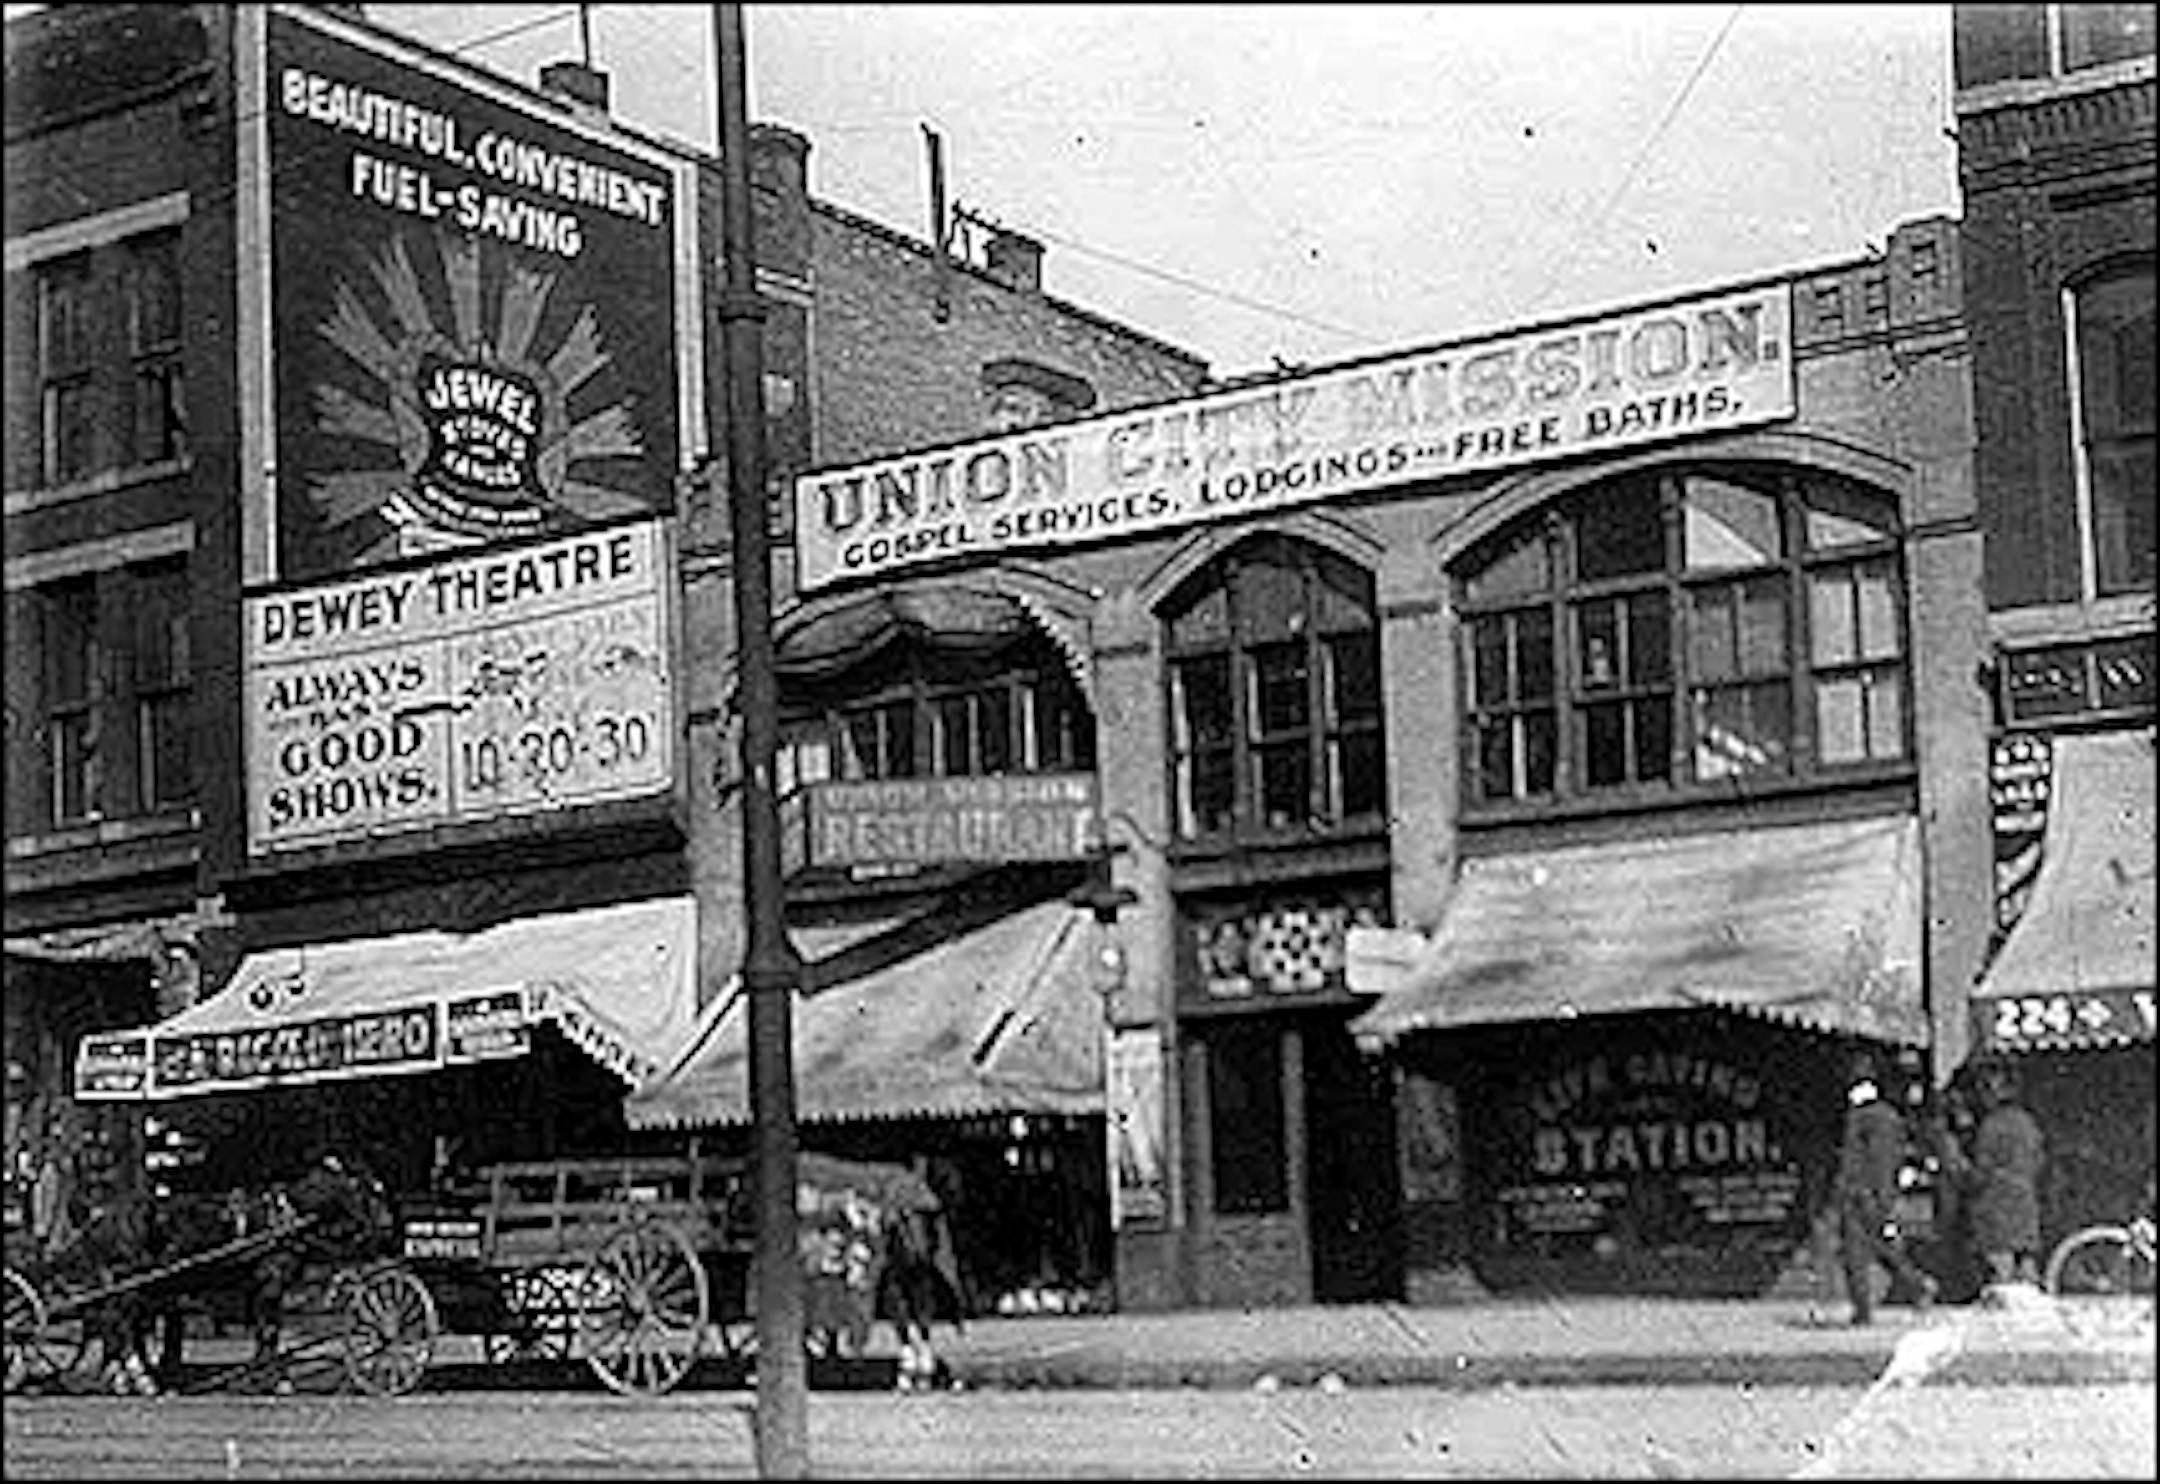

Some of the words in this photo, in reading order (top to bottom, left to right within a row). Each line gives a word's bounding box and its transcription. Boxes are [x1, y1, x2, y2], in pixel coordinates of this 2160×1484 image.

[282, 69, 474, 169] BEAUTIFUL,
[477, 132, 664, 225] CONVENIENT
[353, 154, 581, 258] FUEL-SAVING
[425, 368, 537, 435] JEWEL
[819, 439, 1071, 532] UNION
[1107, 386, 1316, 482] CITY
[1347, 303, 1779, 441] MISSION.
[845, 524, 974, 568] GOSPEL
[264, 580, 411, 644] DEWEY
[429, 535, 632, 615] THEATRE
[266, 657, 425, 711] ALWAYS
[281, 720, 423, 778] GOOD
[269, 768, 439, 832] SHOWS.
